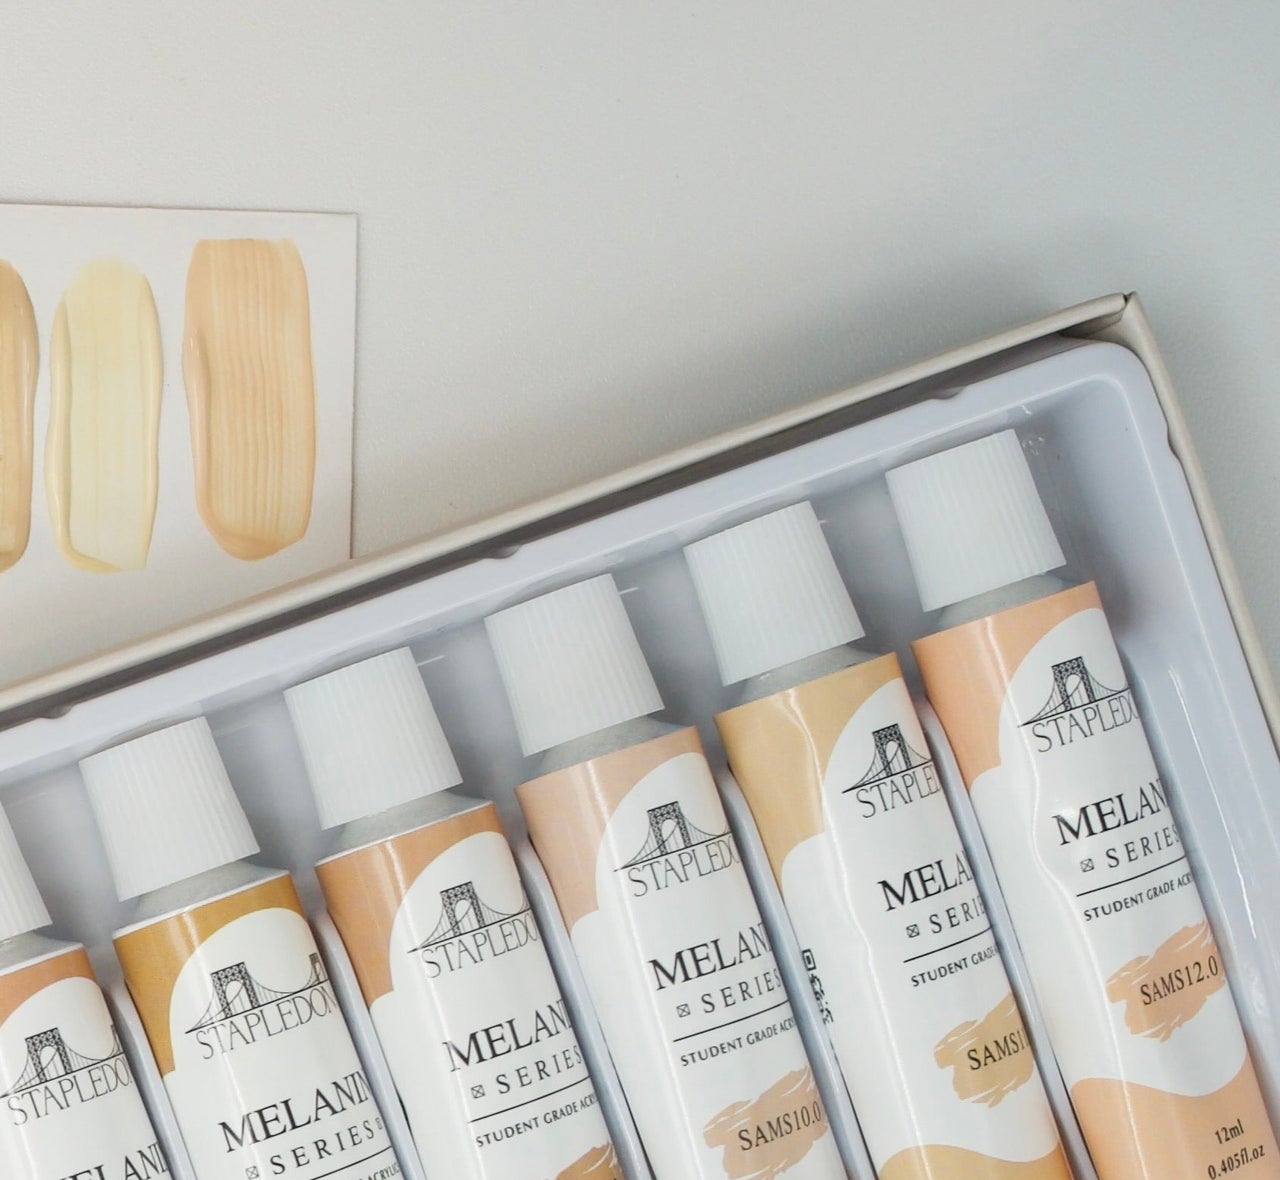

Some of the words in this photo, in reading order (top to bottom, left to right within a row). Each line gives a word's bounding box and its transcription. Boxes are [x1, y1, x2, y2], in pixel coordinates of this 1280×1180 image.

[1083, 892, 1144, 922] STUDENT
[1145, 879, 1175, 901] GRADE
[910, 957, 969, 988] STUDENT
[1140, 955, 1219, 1006] SAMS12.0
[680, 1036, 743, 1067] STUDENT
[745, 1023, 779, 1046] GRADE
[495, 1045, 582, 1095] SERIES
[475, 1116, 539, 1148] STUDENT
[543, 1101, 579, 1125] GRADE
[737, 1101, 821, 1151] SAMS10.0
[1214, 1118, 1245, 1145] 12ml
[269, 1120, 375, 1175] SERIES
[1207, 1144, 1266, 1180] 0.405fl.oz
